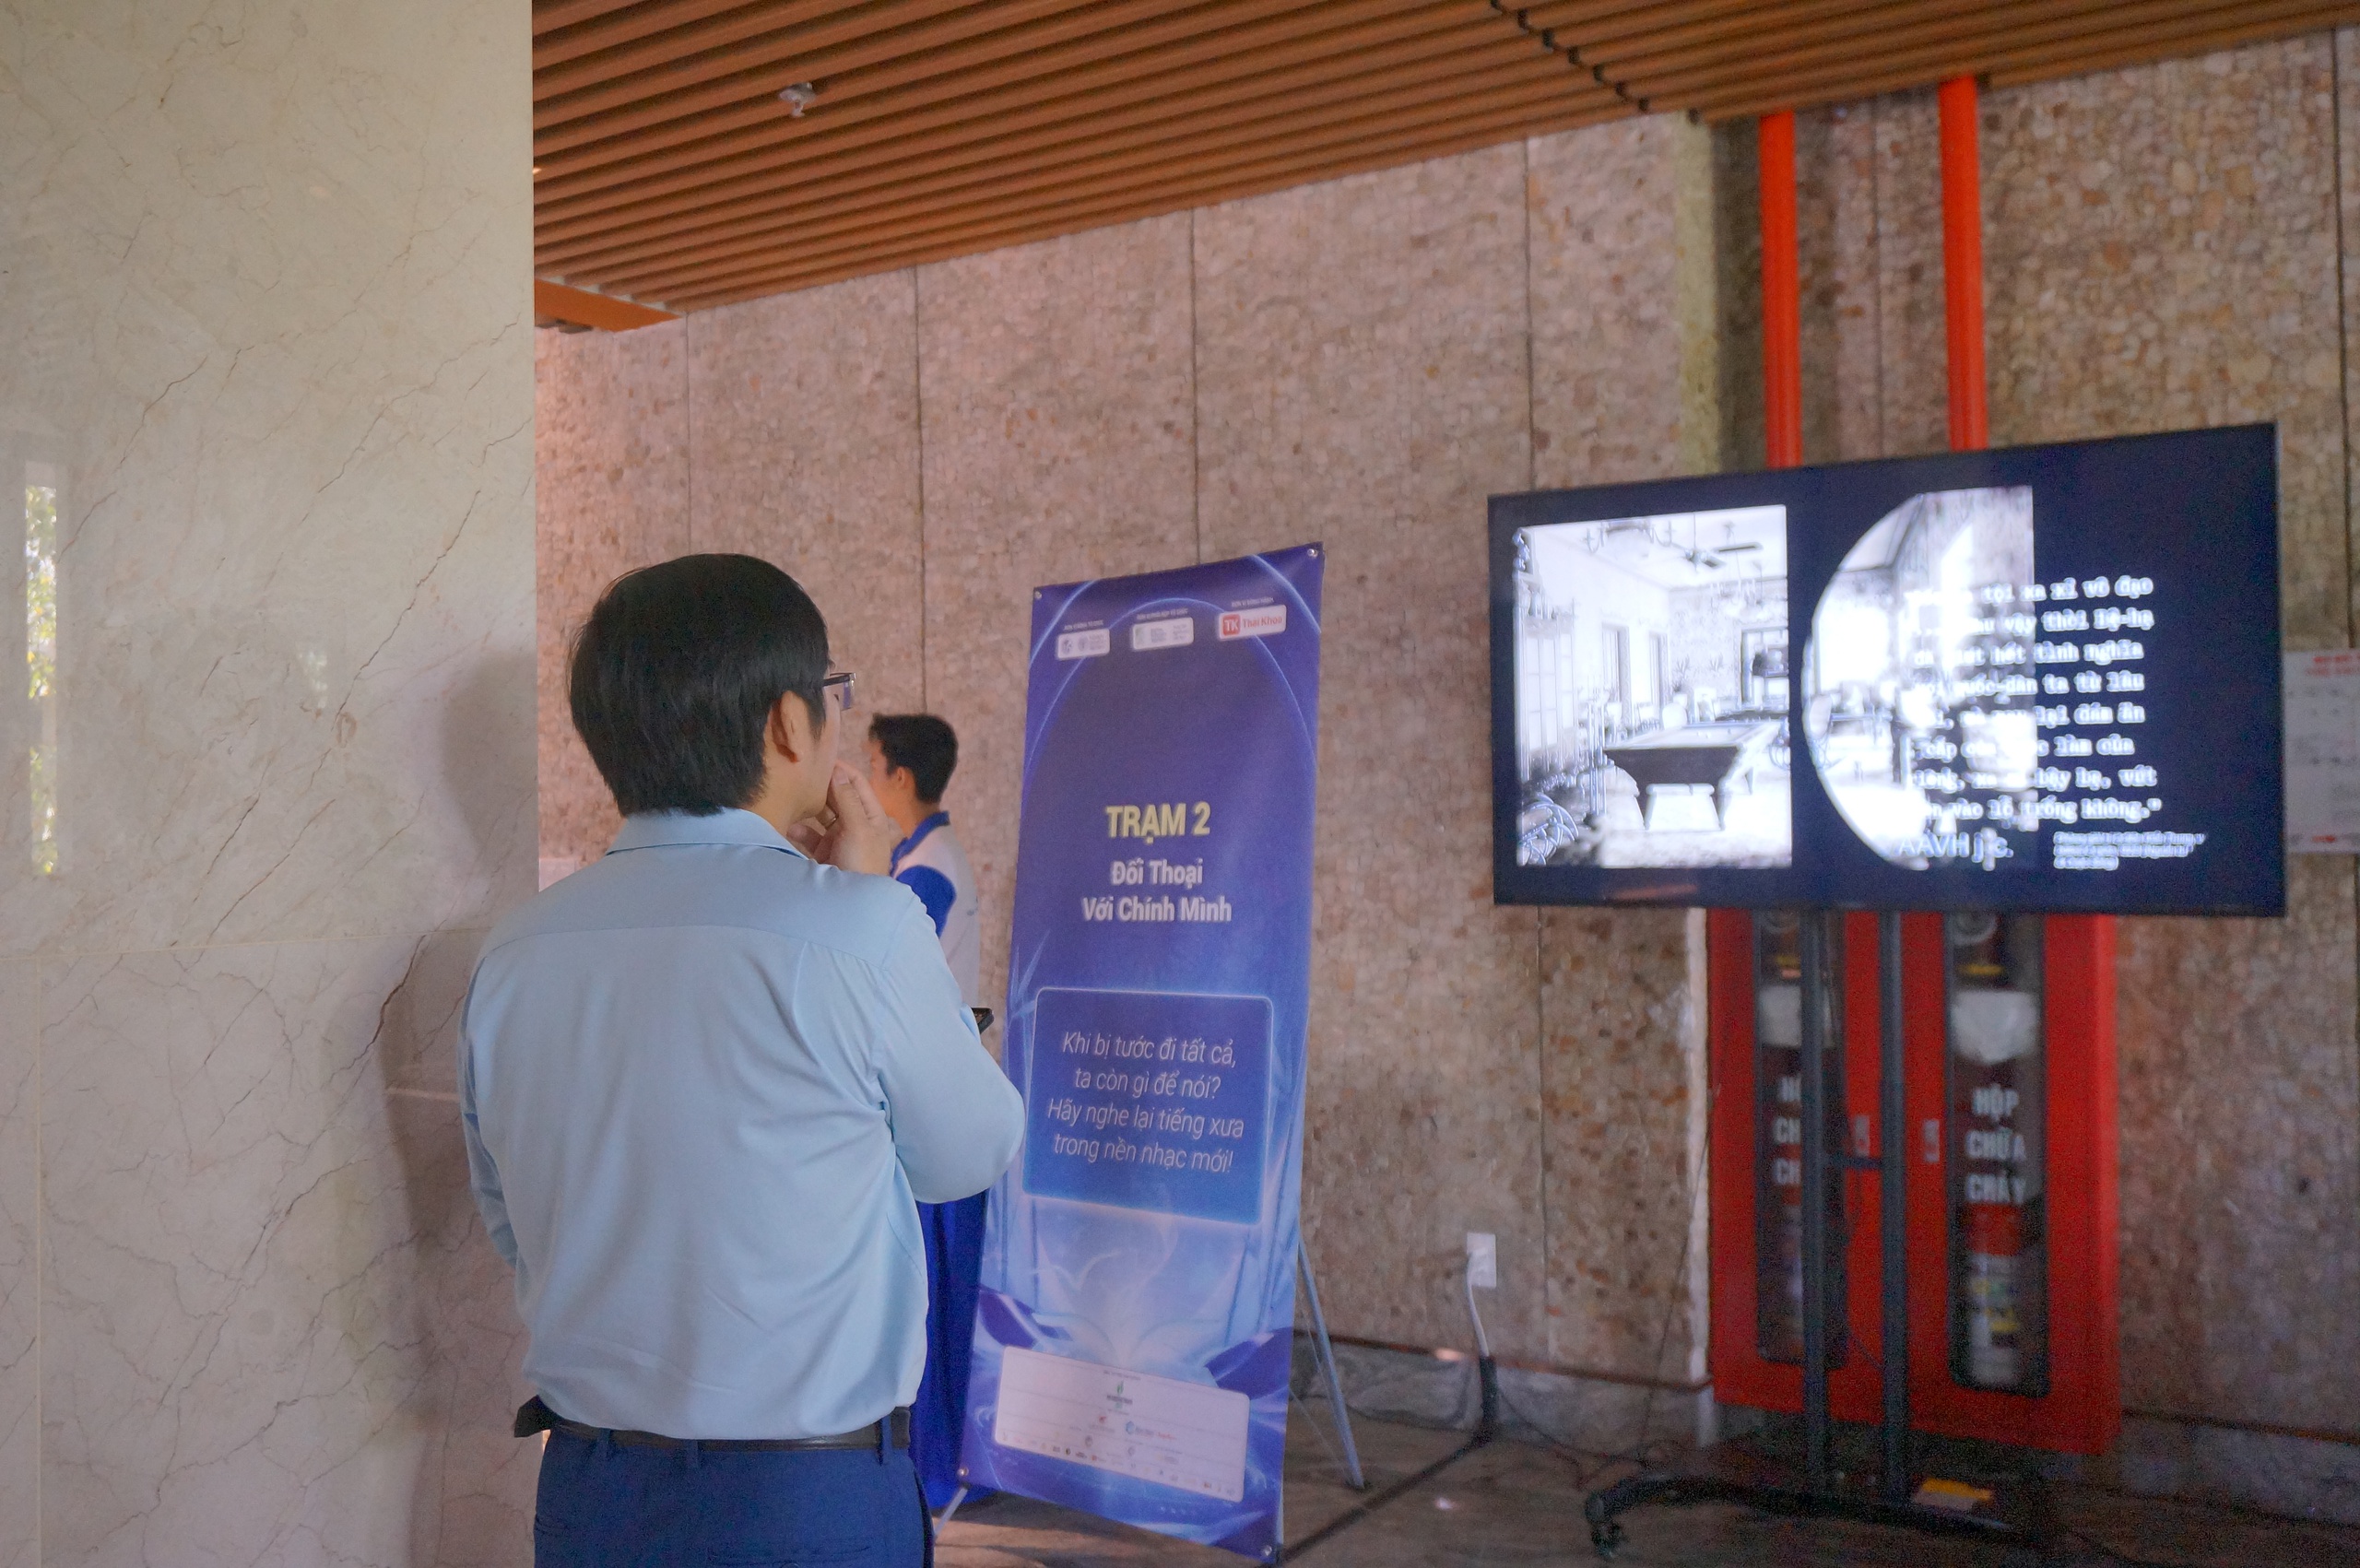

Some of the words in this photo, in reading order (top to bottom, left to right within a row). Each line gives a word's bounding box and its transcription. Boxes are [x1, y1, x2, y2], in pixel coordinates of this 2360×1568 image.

[1223, 619, 1240, 631] TK
[1105, 803, 1186, 844] TRẠM
[1193, 801, 1211, 836] 2
[1112, 857, 1144, 885] Đối
[1149, 857, 1204, 889] Thoại
[1082, 896, 1115, 921] Với
[1118, 895, 1175, 922] Chính
[1180, 894, 1232, 922] Mình
[1062, 1032, 1092, 1055] Khi
[1094, 1032, 1111, 1059] bị
[1115, 1035, 1154, 1058] tước
[1159, 1036, 1177, 1061] đi
[1181, 1038, 1206, 1062] tất
[1210, 1039, 1236, 1067] cả,
[1074, 1067, 1092, 1089] ta
[1096, 1068, 1128, 1091] còn
[1133, 1071, 1150, 1098] gì
[1153, 1070, 1180, 1096] để
[1181, 1076, 1221, 1099] nói?
[1047, 1098, 1082, 1127] Hãy
[1086, 1102, 1129, 1130] nghe
[1134, 1105, 1156, 1131] lại
[1158, 1107, 1205, 1139] tiếng
[1209, 1117, 1245, 1138] xưa
[1054, 1134, 1100, 1163] trong
[1103, 1137, 1138, 1161] nền
[1140, 1141, 1187, 1170] nhạc
[1191, 1150, 1233, 1173] mới!
